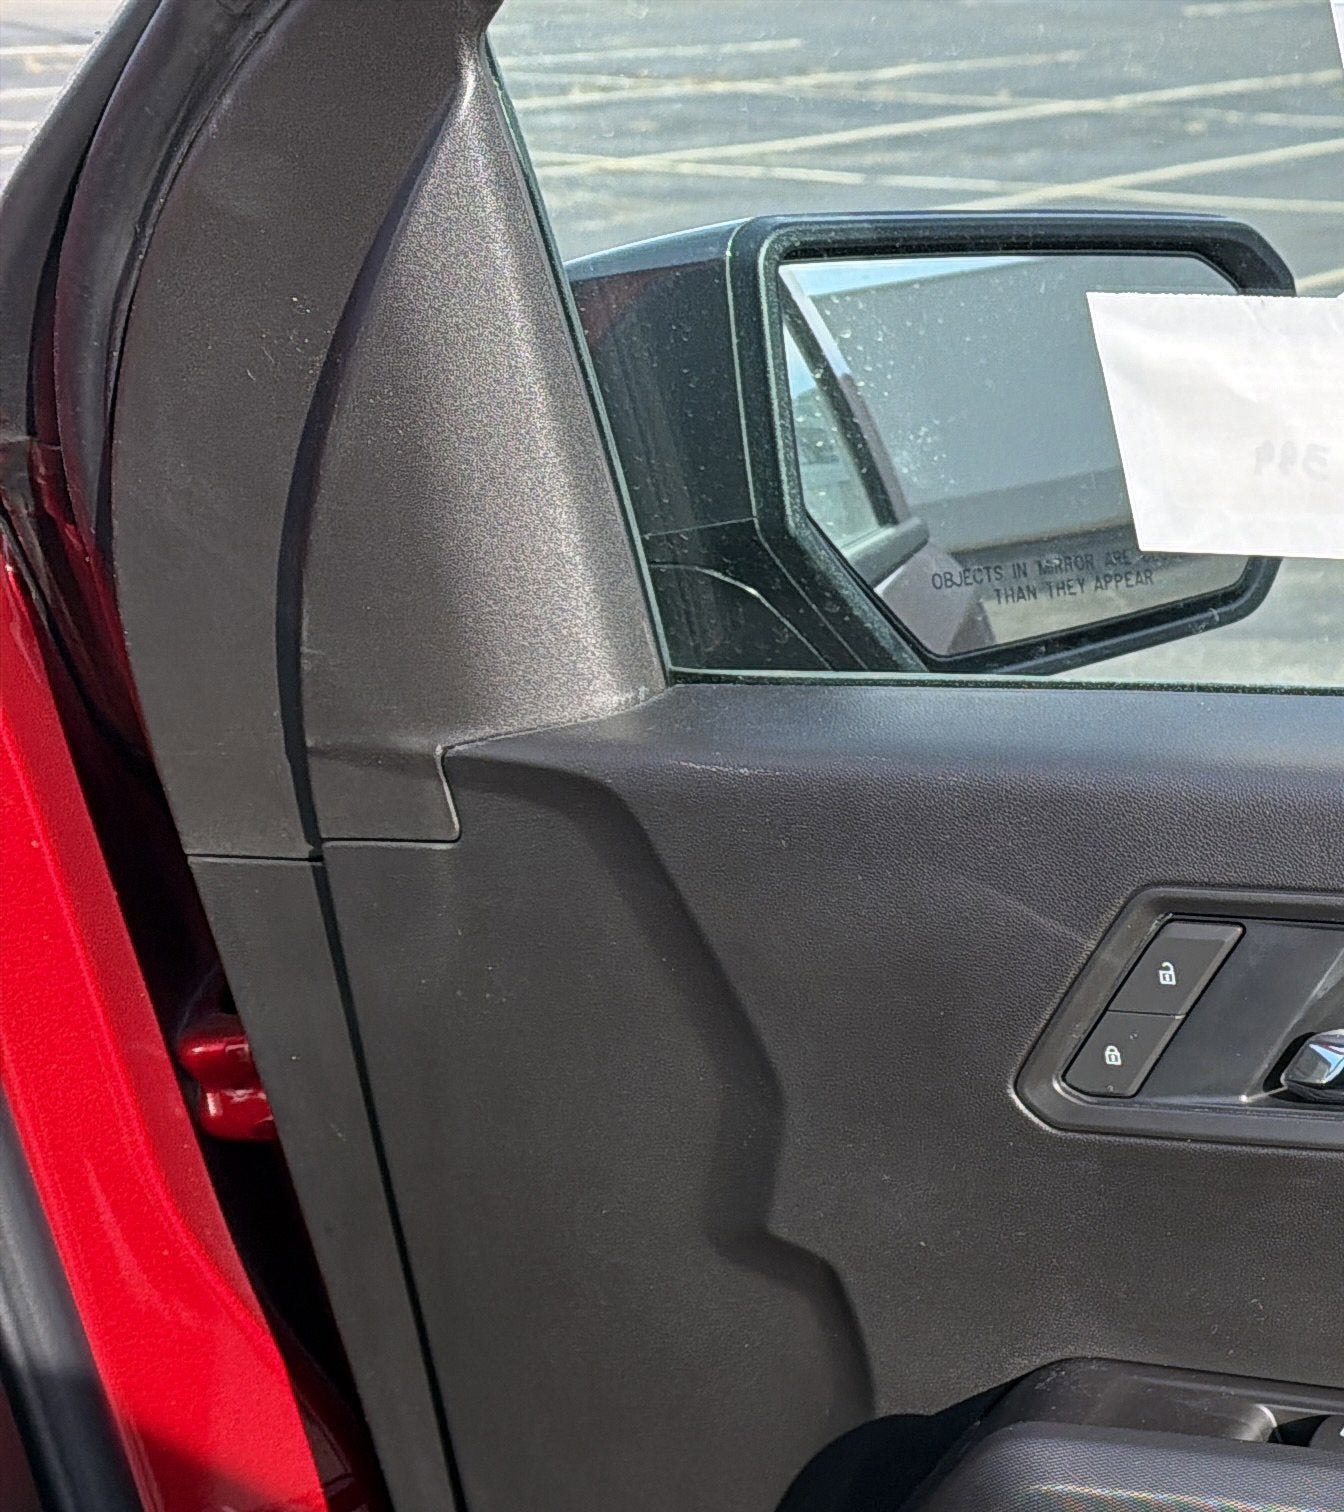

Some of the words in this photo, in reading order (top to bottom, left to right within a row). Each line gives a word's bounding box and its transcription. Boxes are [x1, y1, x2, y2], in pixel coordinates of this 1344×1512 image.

[931, 565, 1004, 590] OBJECTS
[1012, 563, 1028, 579] IN
[1038, 553, 1095, 576] MIRROR
[1104, 550, 1131, 568] ARE
[993, 582, 1038, 605] THAN
[1047, 576, 1085, 599] THEY
[1094, 570, 1154, 592] APPEAR
